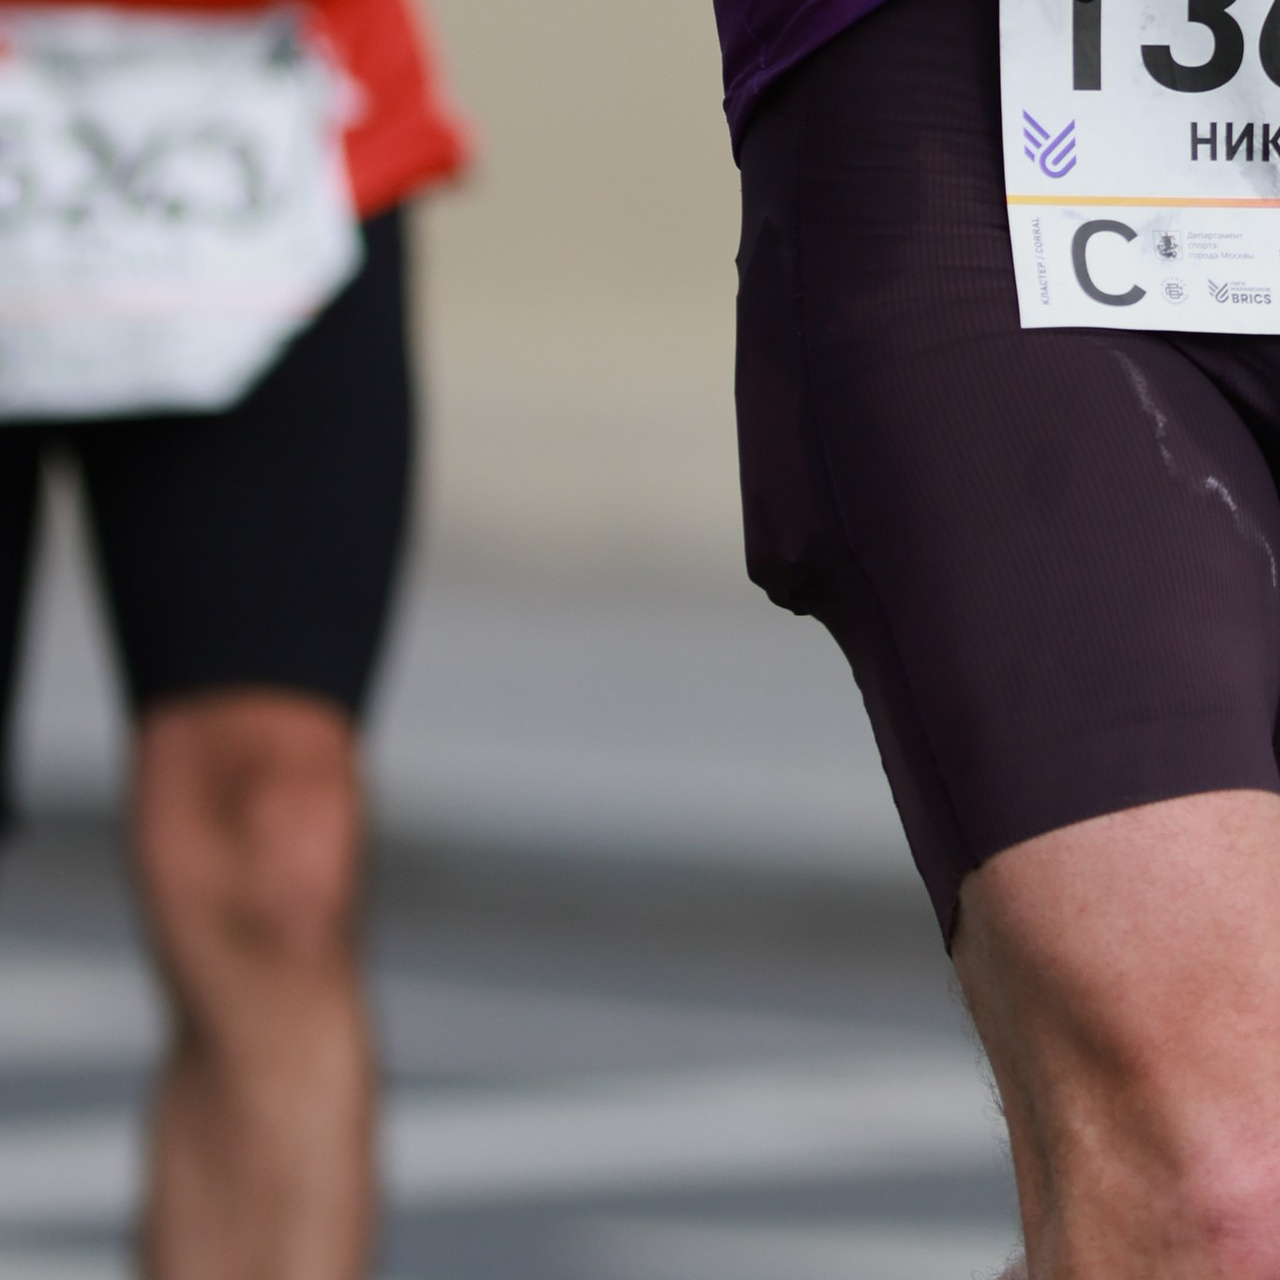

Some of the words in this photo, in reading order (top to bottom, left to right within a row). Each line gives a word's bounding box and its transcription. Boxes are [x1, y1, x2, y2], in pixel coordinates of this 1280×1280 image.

[1031, 217, 1043, 254] CORRAL
[1037, 262, 1050, 306] КЛАСТЕР
[1232, 293, 1272, 305] BRICS
